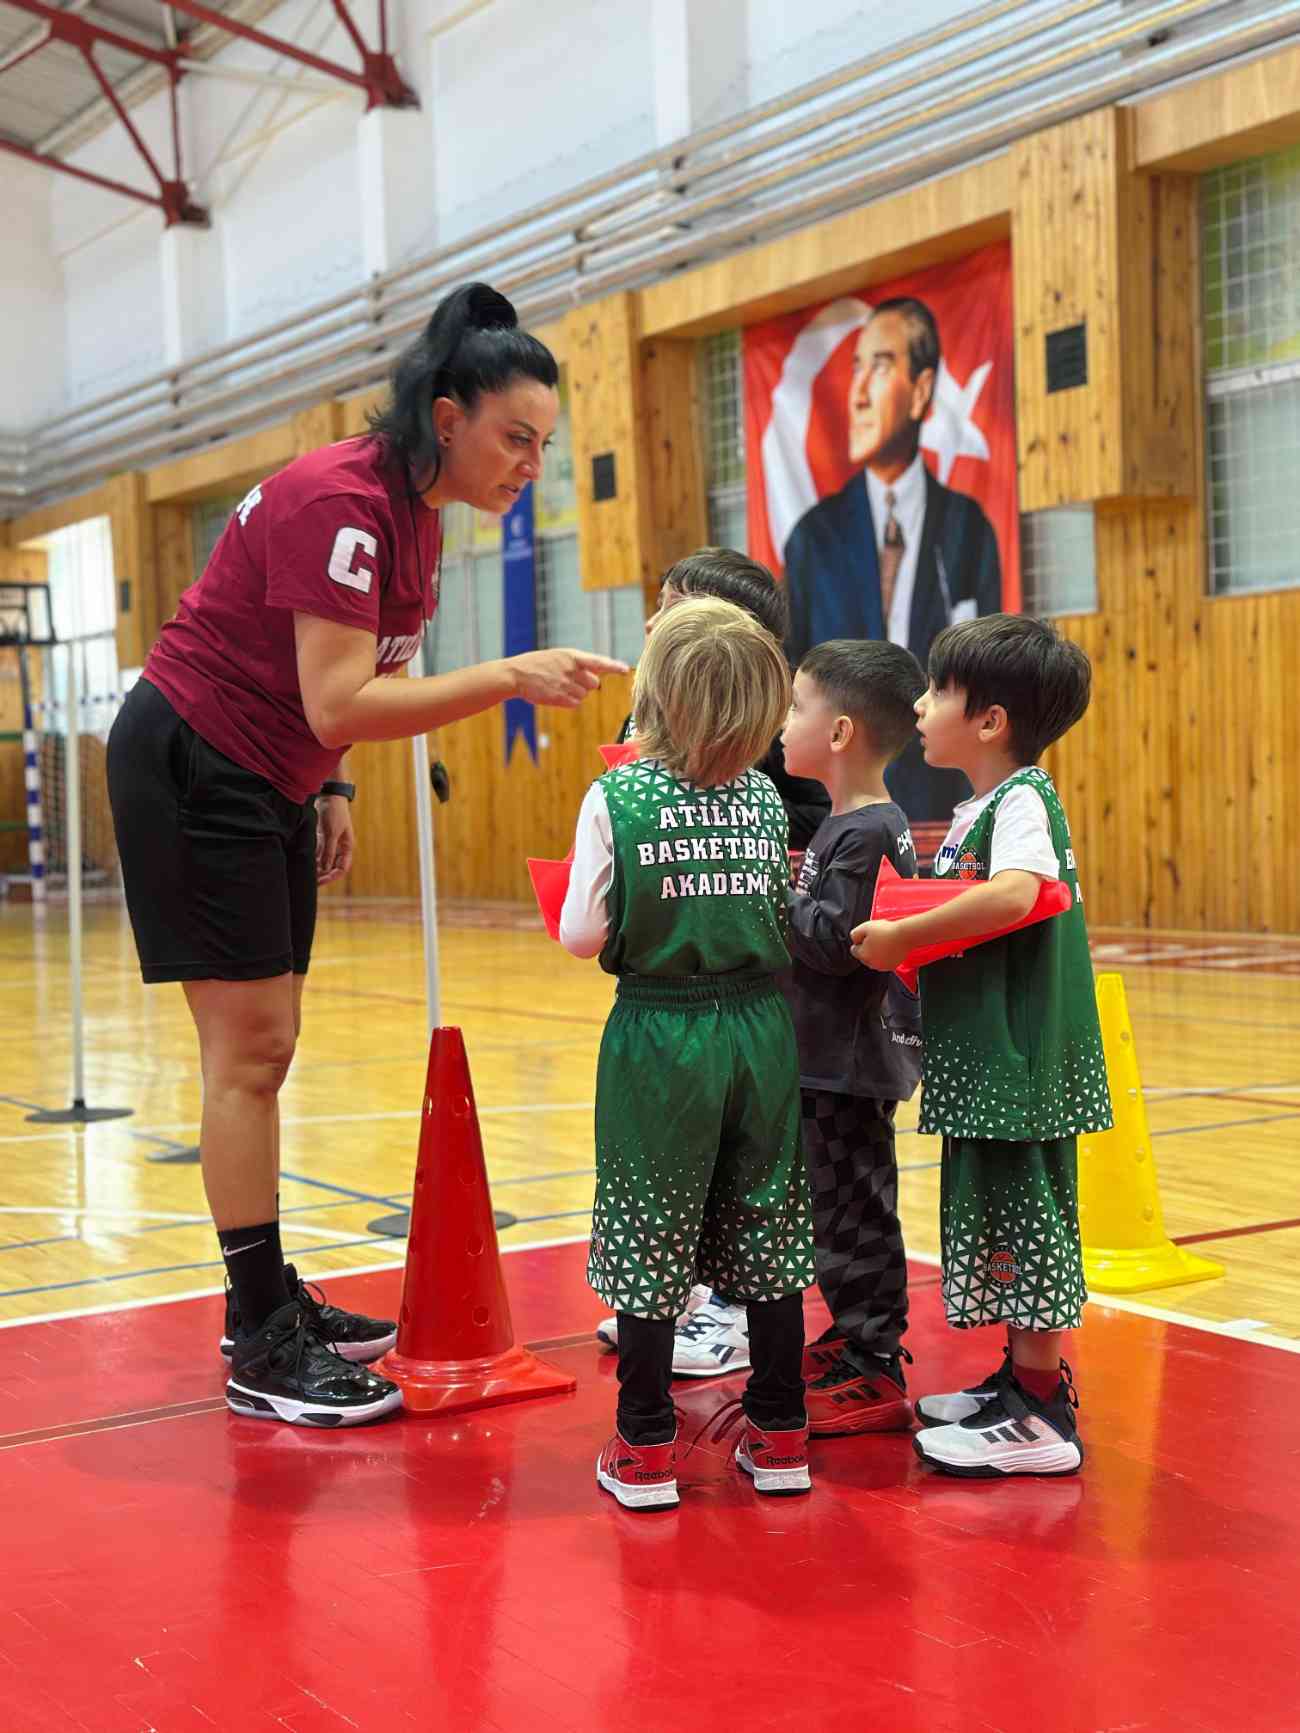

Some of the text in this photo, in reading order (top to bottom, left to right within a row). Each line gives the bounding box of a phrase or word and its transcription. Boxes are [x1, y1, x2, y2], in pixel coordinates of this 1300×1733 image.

[328, 527, 377, 593] C
[659, 804, 762, 830] ATILIM
[637, 836, 781, 866] BASKETBOL
